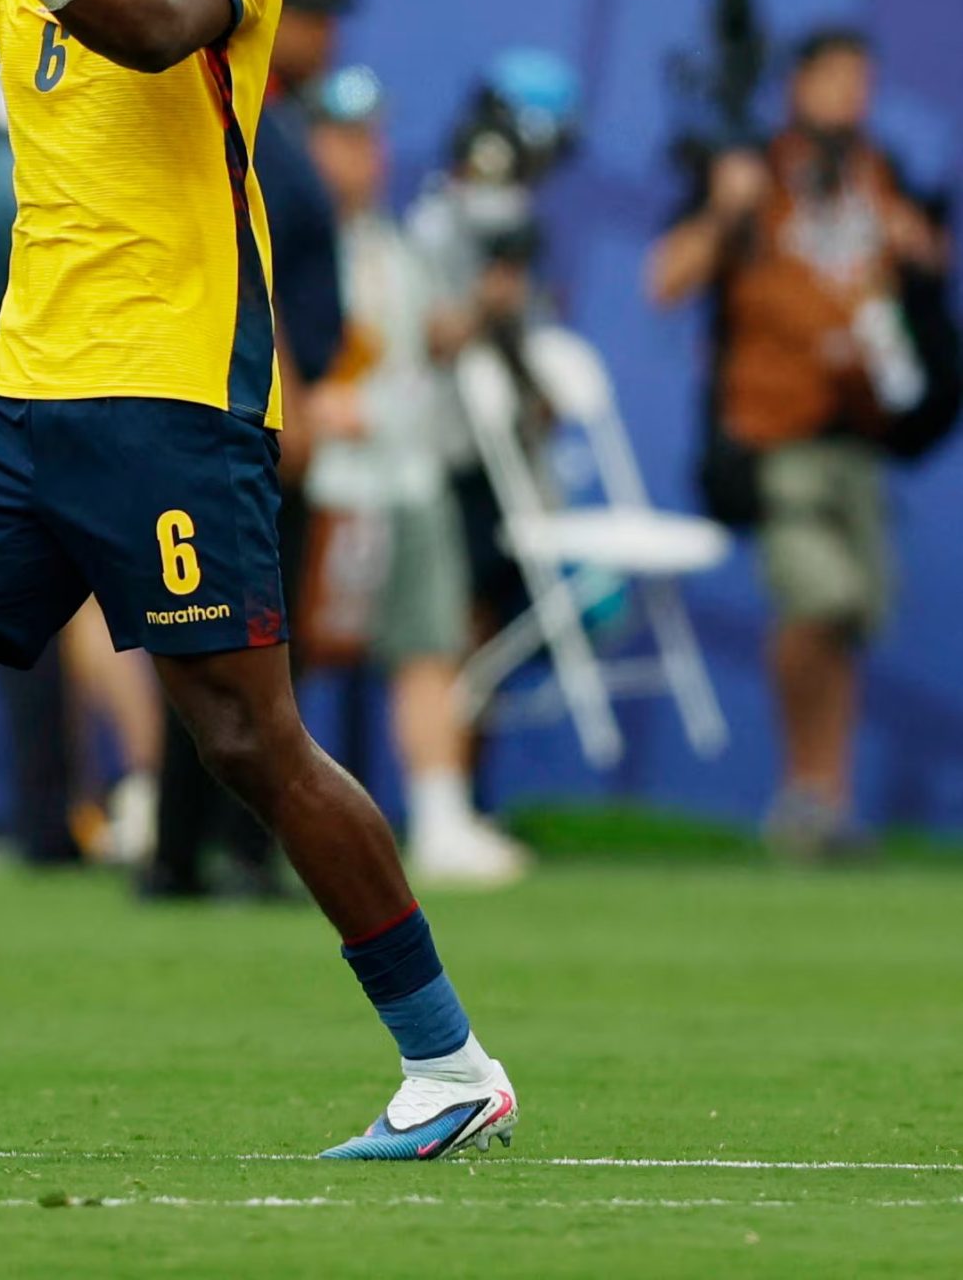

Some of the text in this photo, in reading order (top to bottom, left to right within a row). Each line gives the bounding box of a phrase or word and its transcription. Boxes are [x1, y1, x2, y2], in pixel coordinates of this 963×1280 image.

[35, 22, 69, 92] 6
[156, 509, 201, 595] 6
[146, 604, 230, 624] marathon
